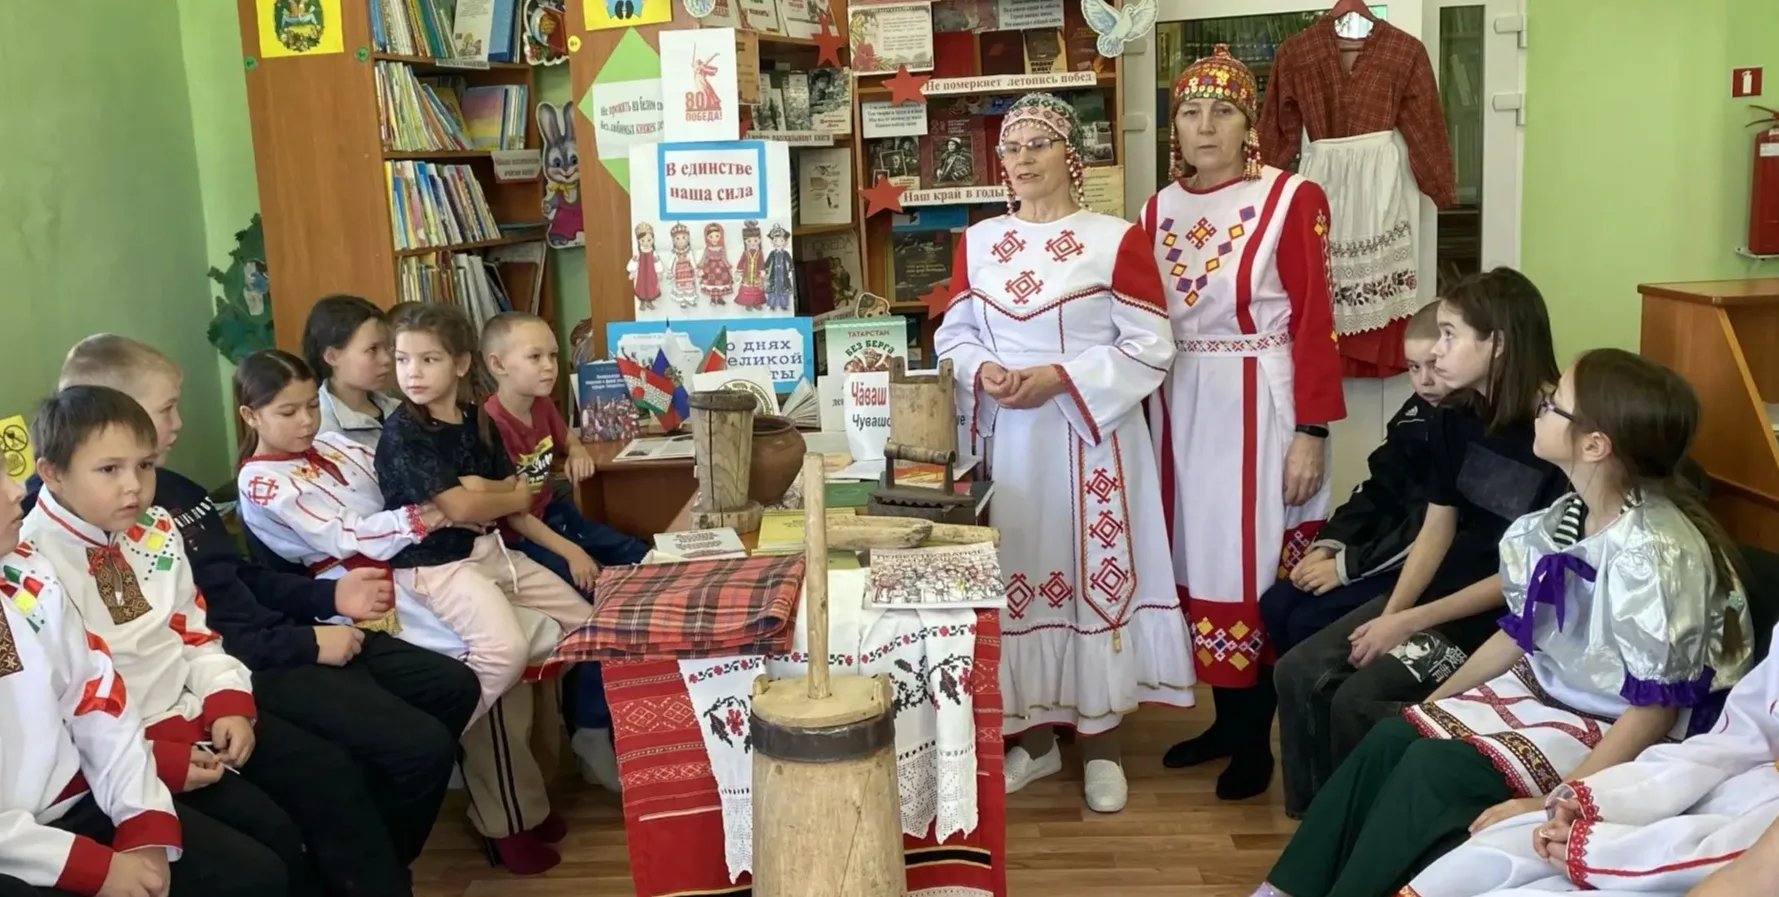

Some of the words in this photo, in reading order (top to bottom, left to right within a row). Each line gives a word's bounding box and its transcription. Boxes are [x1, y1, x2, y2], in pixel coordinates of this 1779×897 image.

[926, 81, 940, 91] Не
[943, 79, 1002, 91] померкнет
[1007, 75, 1058, 87] летопись
[1061, 72, 1093, 83] побед
[685, 91, 705, 110] 80
[685, 111, 723, 122] ПОБЕДА!
[666, 162, 676, 176] В
[681, 162, 753, 177] единстве
[670, 186, 713, 201] наша
[717, 186, 754, 201] сила
[904, 191, 930, 202] Наш
[933, 188, 961, 203] край
[966, 190, 973, 198] в
[976, 189, 1004, 198] годы
[848, 330, 890, 338] ТАТАРСТАН
[743, 340, 791, 352] днях
[845, 342, 863, 357] БЕЗ
[727, 352, 802, 366] еликой
